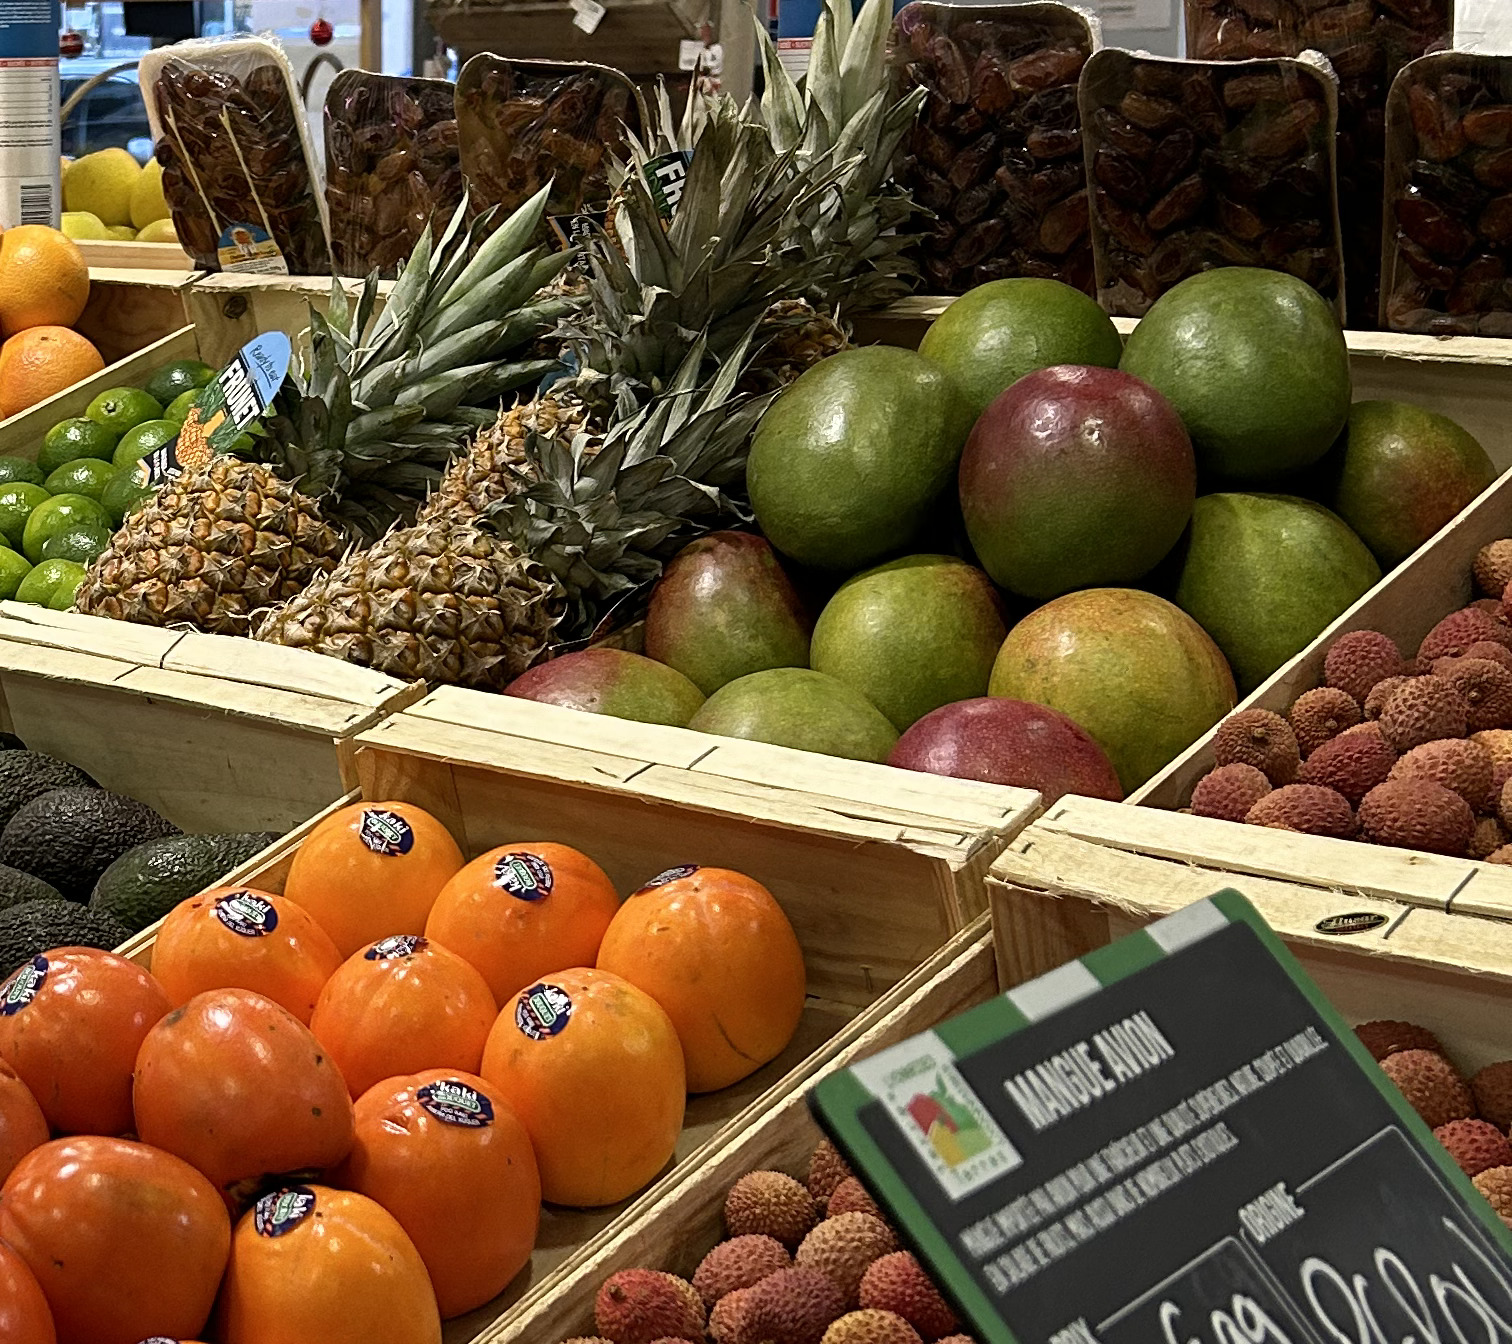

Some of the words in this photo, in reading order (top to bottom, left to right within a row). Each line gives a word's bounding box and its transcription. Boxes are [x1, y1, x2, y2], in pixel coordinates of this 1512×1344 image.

[218, 358, 261, 431] FRUNET
[21, 969, 46, 1002] kaki
[438, 1081, 477, 1101] kaki
[1003, 1040, 1115, 1132] MANGUE
[1091, 1010, 1177, 1091] AVION
[1238, 1181, 1305, 1244] ORIGINE
